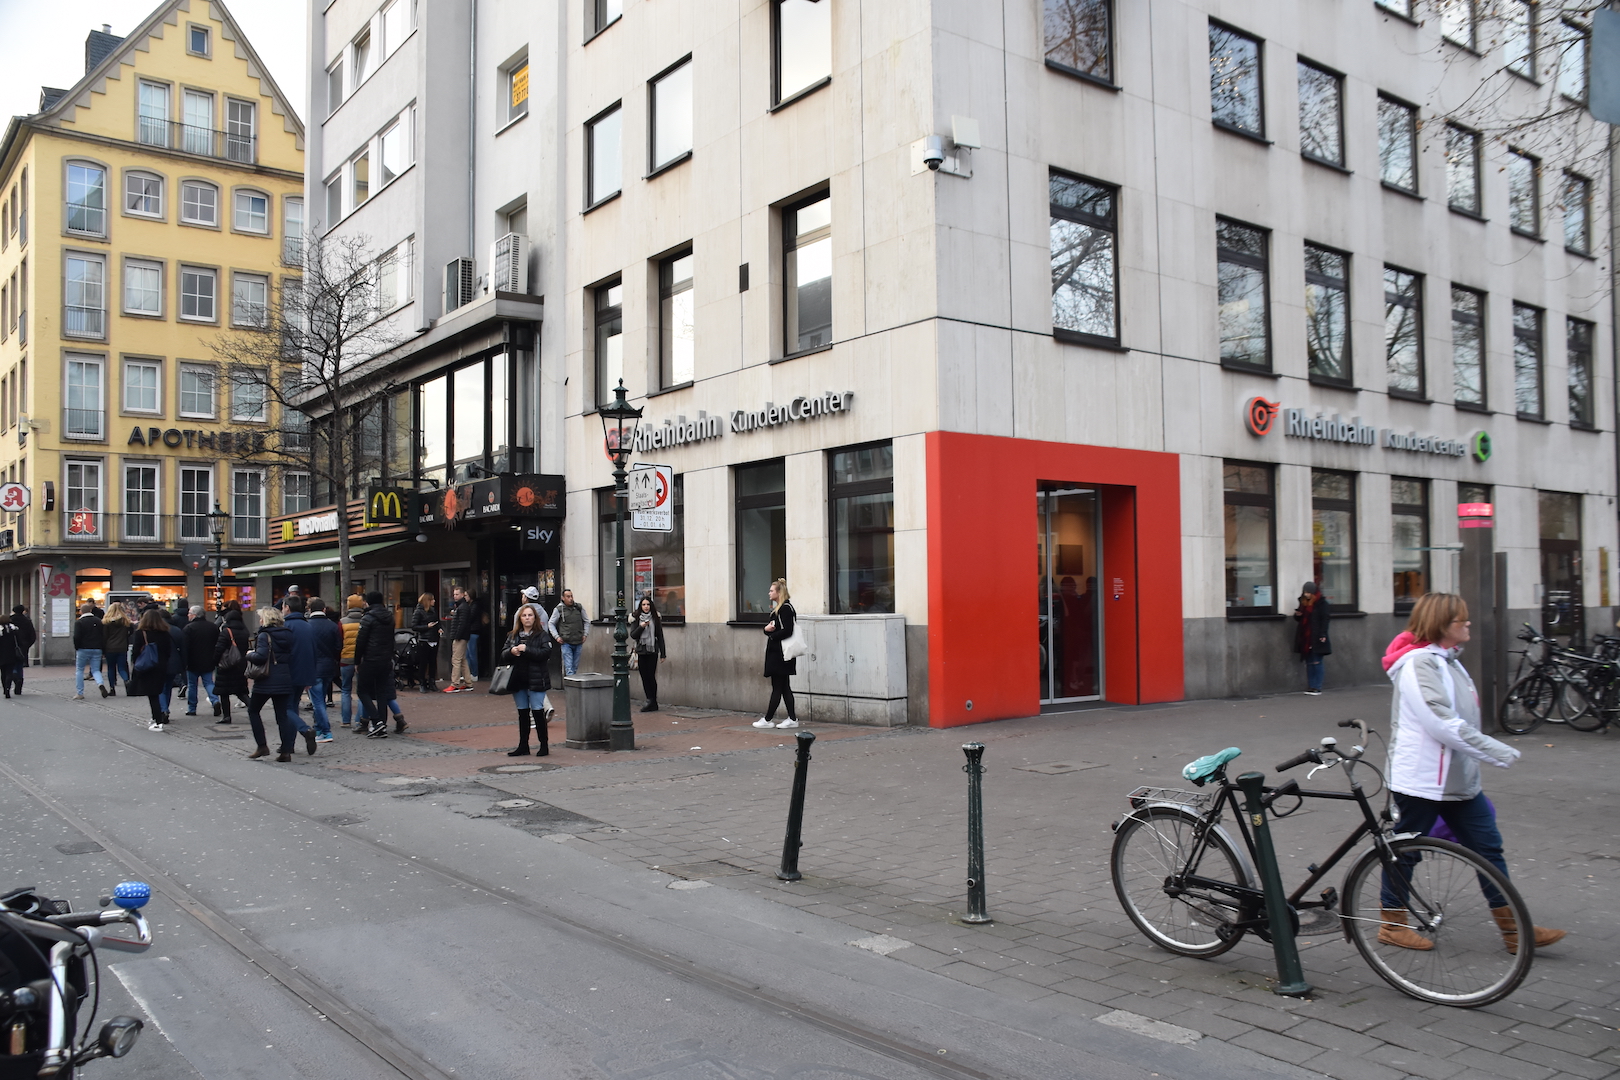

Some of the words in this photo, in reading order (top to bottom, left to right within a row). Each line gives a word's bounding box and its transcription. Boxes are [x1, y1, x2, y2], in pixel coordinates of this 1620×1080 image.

[634, 410, 722, 452] Rheinbahn
[730, 391, 854, 433] KundenCenter
[1286, 408, 1376, 445] Rheinbahn
[1383, 428, 1466, 457] KundenCenter
[128, 425, 265, 453] APOTHEKE
[482, 503, 500, 513] BACARDI
[527, 526, 553, 543] sky
